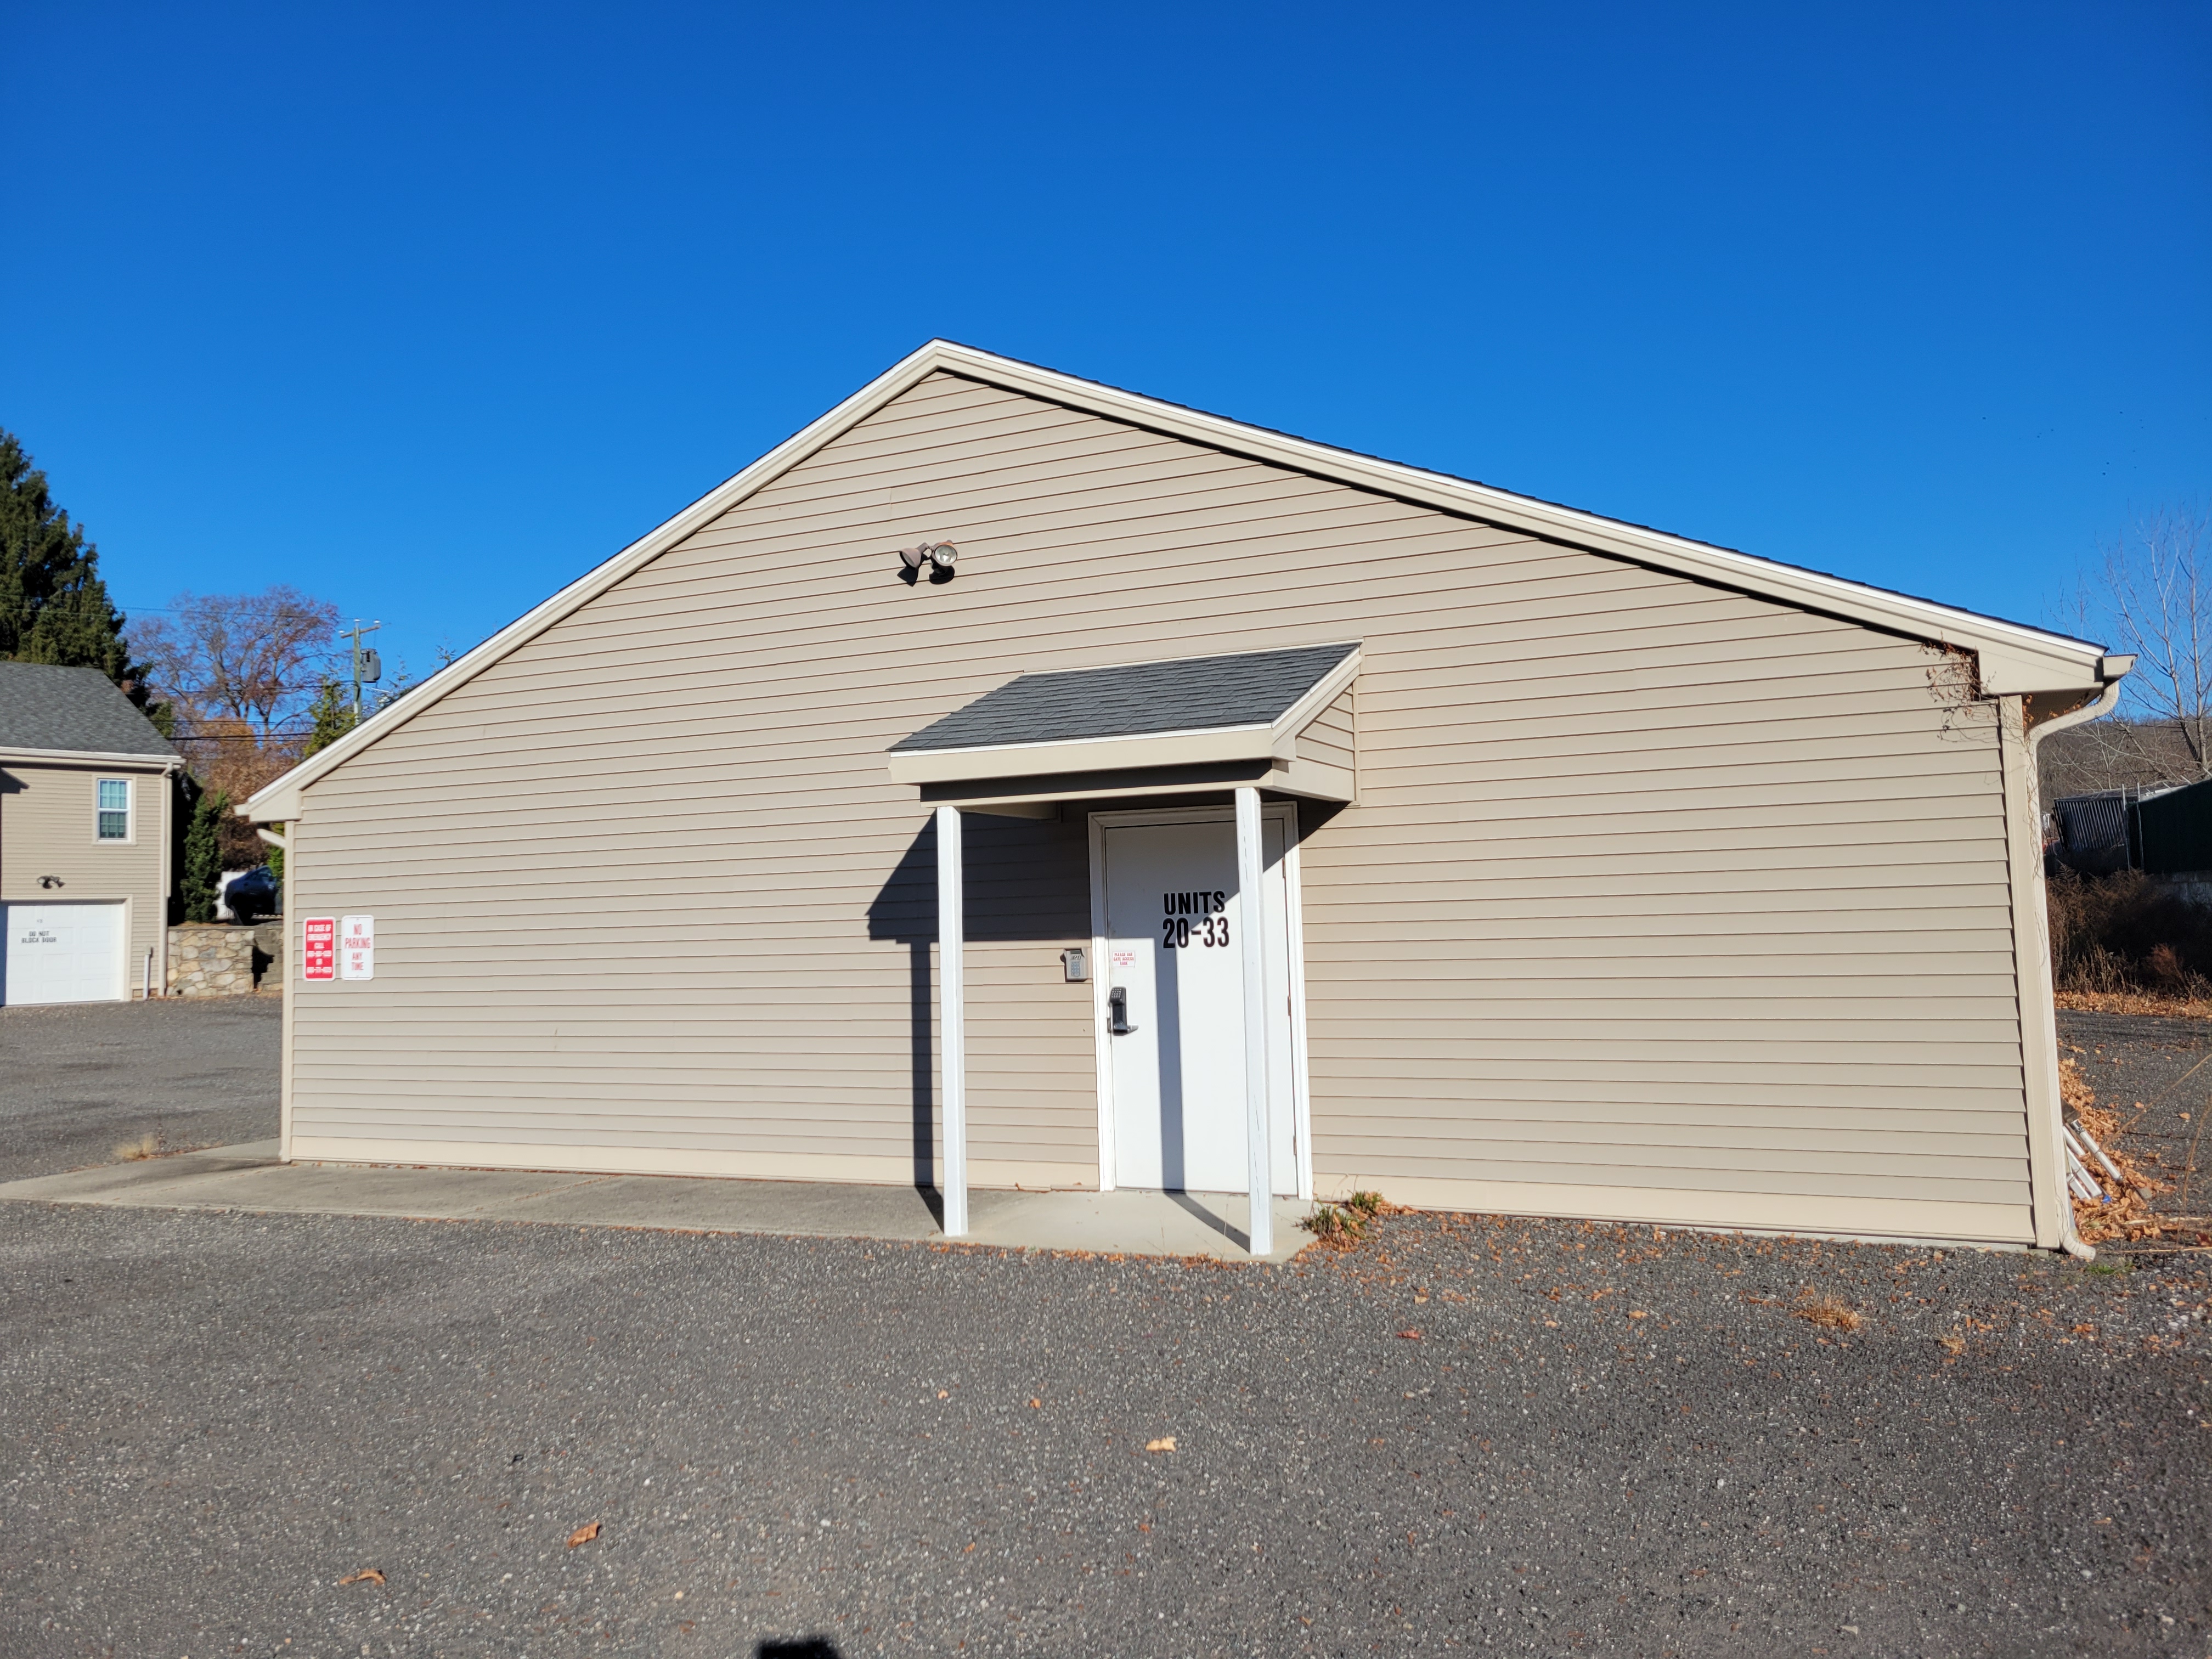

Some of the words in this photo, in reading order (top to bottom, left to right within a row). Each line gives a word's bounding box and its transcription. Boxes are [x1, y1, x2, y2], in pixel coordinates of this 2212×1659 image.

[1164, 890, 1225, 915] UNITS
[353, 924, 362, 935] NO
[1163, 917, 1229, 949] 20-33
[345, 938, 370, 948] PARKING
